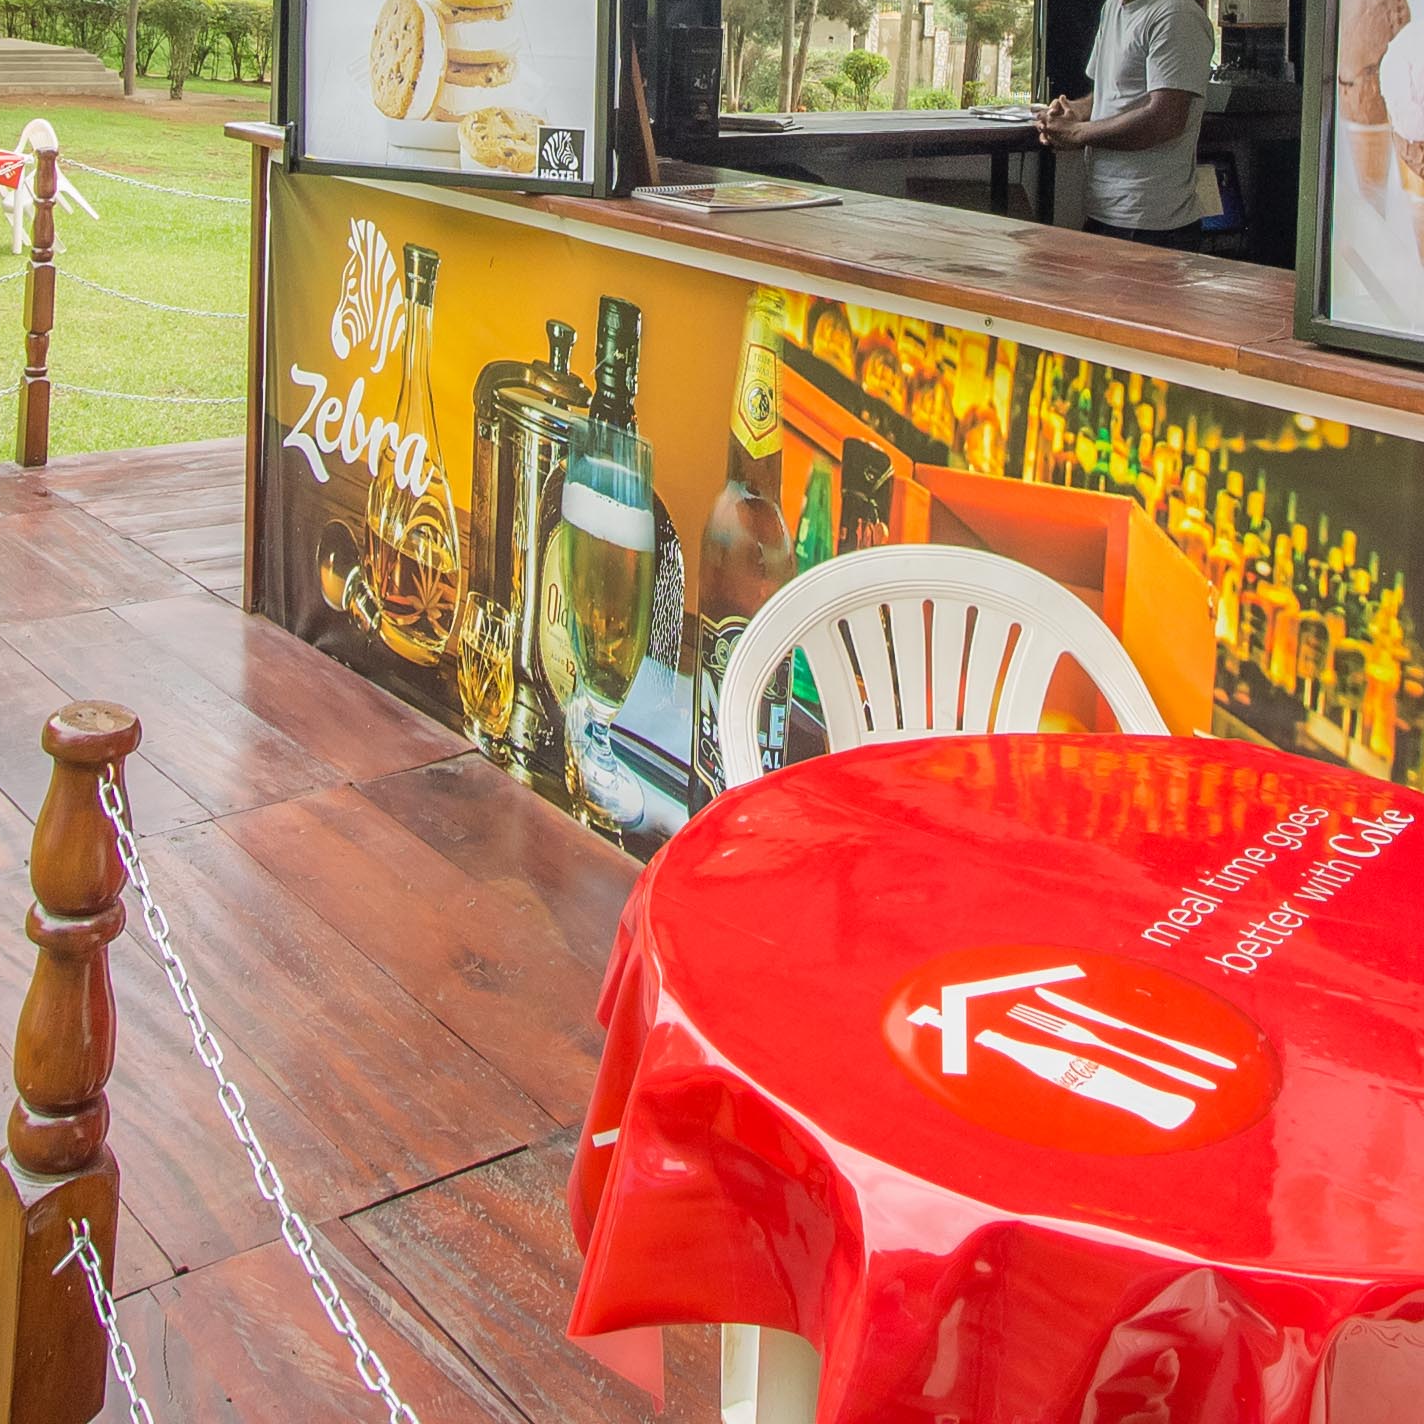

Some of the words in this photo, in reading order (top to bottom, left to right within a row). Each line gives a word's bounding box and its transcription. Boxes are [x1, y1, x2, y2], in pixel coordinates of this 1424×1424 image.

[540, 168, 581, 181] HOTEL
[282, 363, 436, 498] Zebra
[1141, 887, 1223, 947] meal
[1198, 847, 1276, 892] time
[1263, 805, 1329, 850] goes
[1205, 901, 1309, 974] better
[1293, 861, 1362, 902] with
[1329, 809, 1414, 857] Coke
